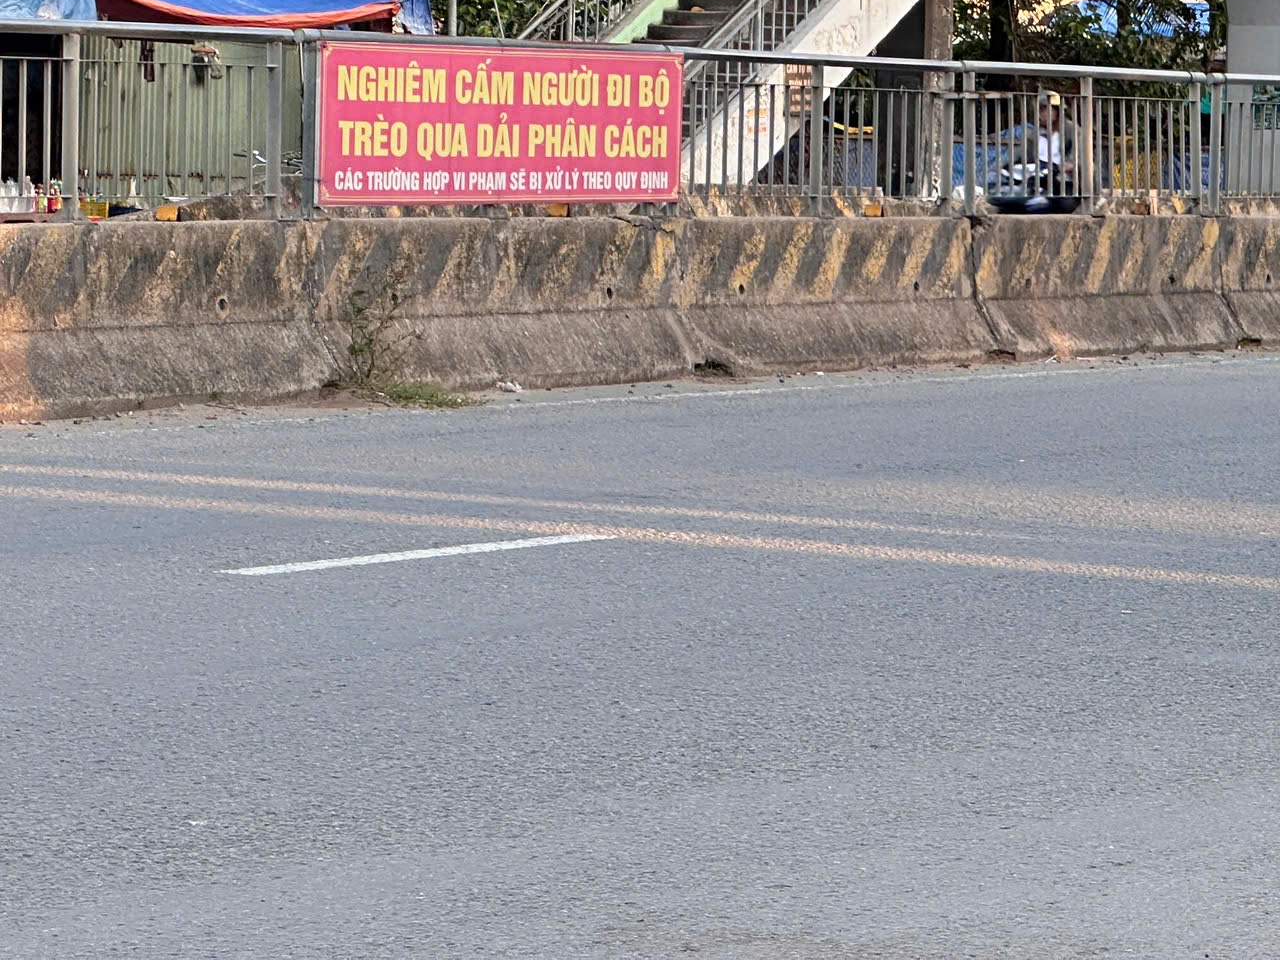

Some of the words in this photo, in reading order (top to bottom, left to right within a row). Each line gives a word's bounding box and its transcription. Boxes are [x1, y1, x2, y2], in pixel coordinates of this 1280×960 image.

[337, 60, 446, 103] NGHIÊM
[455, 58, 514, 105] CẤM
[523, 65, 599, 107] NGƯỜI
[607, 73, 631, 107] ĐI
[638, 68, 670, 115] BỘ
[338, 113, 408, 157] TRÈO
[416, 122, 469, 161] QUA
[476, 112, 519, 158] DẢI
[528, 117, 597, 158] PHÂN
[604, 118, 668, 158] CÁCH
[334, 167, 363, 190] CÁC
[366, 167, 420, 191] TRƯỜNG
[423, 170, 450, 195] HỢP
[453, 171, 466, 190] VI
[469, 171, 507, 195] PHẠM
[510, 169, 526, 190] SẼ
[529, 171, 542, 194] BỊ
[545, 166, 564, 190] XỬ
[565, 168, 580, 190] LÝ
[582, 171, 612, 190] THEO
[615, 171, 638, 191] QUY
[640, 171, 669, 193] ĐỊNH
